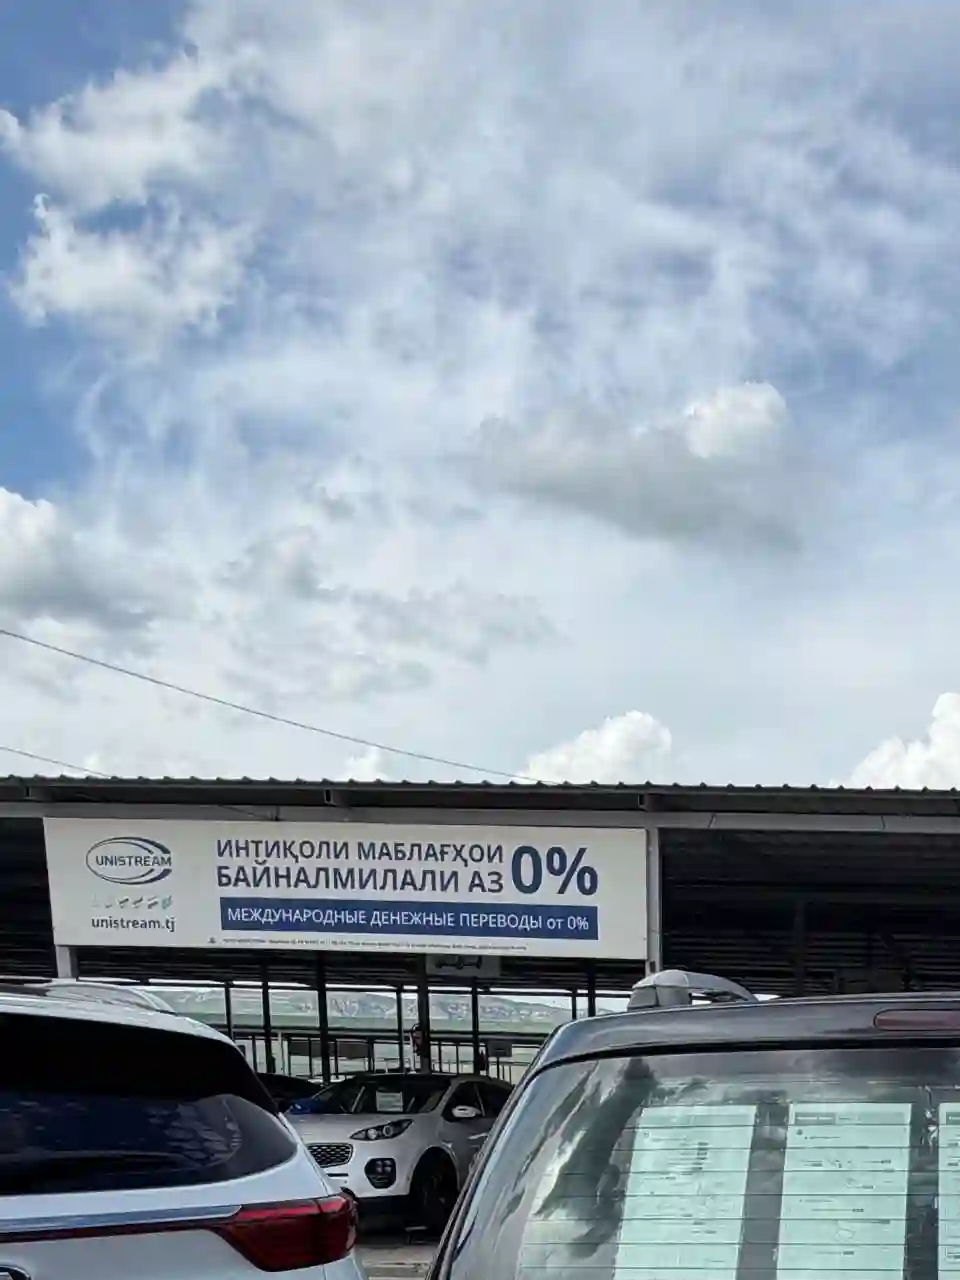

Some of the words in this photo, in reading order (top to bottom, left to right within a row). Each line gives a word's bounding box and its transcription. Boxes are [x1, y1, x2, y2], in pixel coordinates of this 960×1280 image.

[95, 855, 172, 867] UNISTREAM
[217, 839, 349, 863] ИНТИҚОЛИ
[356, 842, 503, 867] МАБЛАҒҲОИ
[217, 859, 459, 892] БАЙНАЛМИЛАЛИ
[468, 870, 504, 893] АЗ
[511, 845, 598, 896] 0%
[91, 916, 175, 933] unistream.tj
[227, 907, 367, 925] МЕЖДУНАРОДНЫЕ
[370, 911, 456, 928] ДЕНЕЖНЫЕ
[459, 913, 542, 931] ПЕРЕВОДЫ
[546, 918, 564, 929] от
[567, 916, 589, 930] 0%
